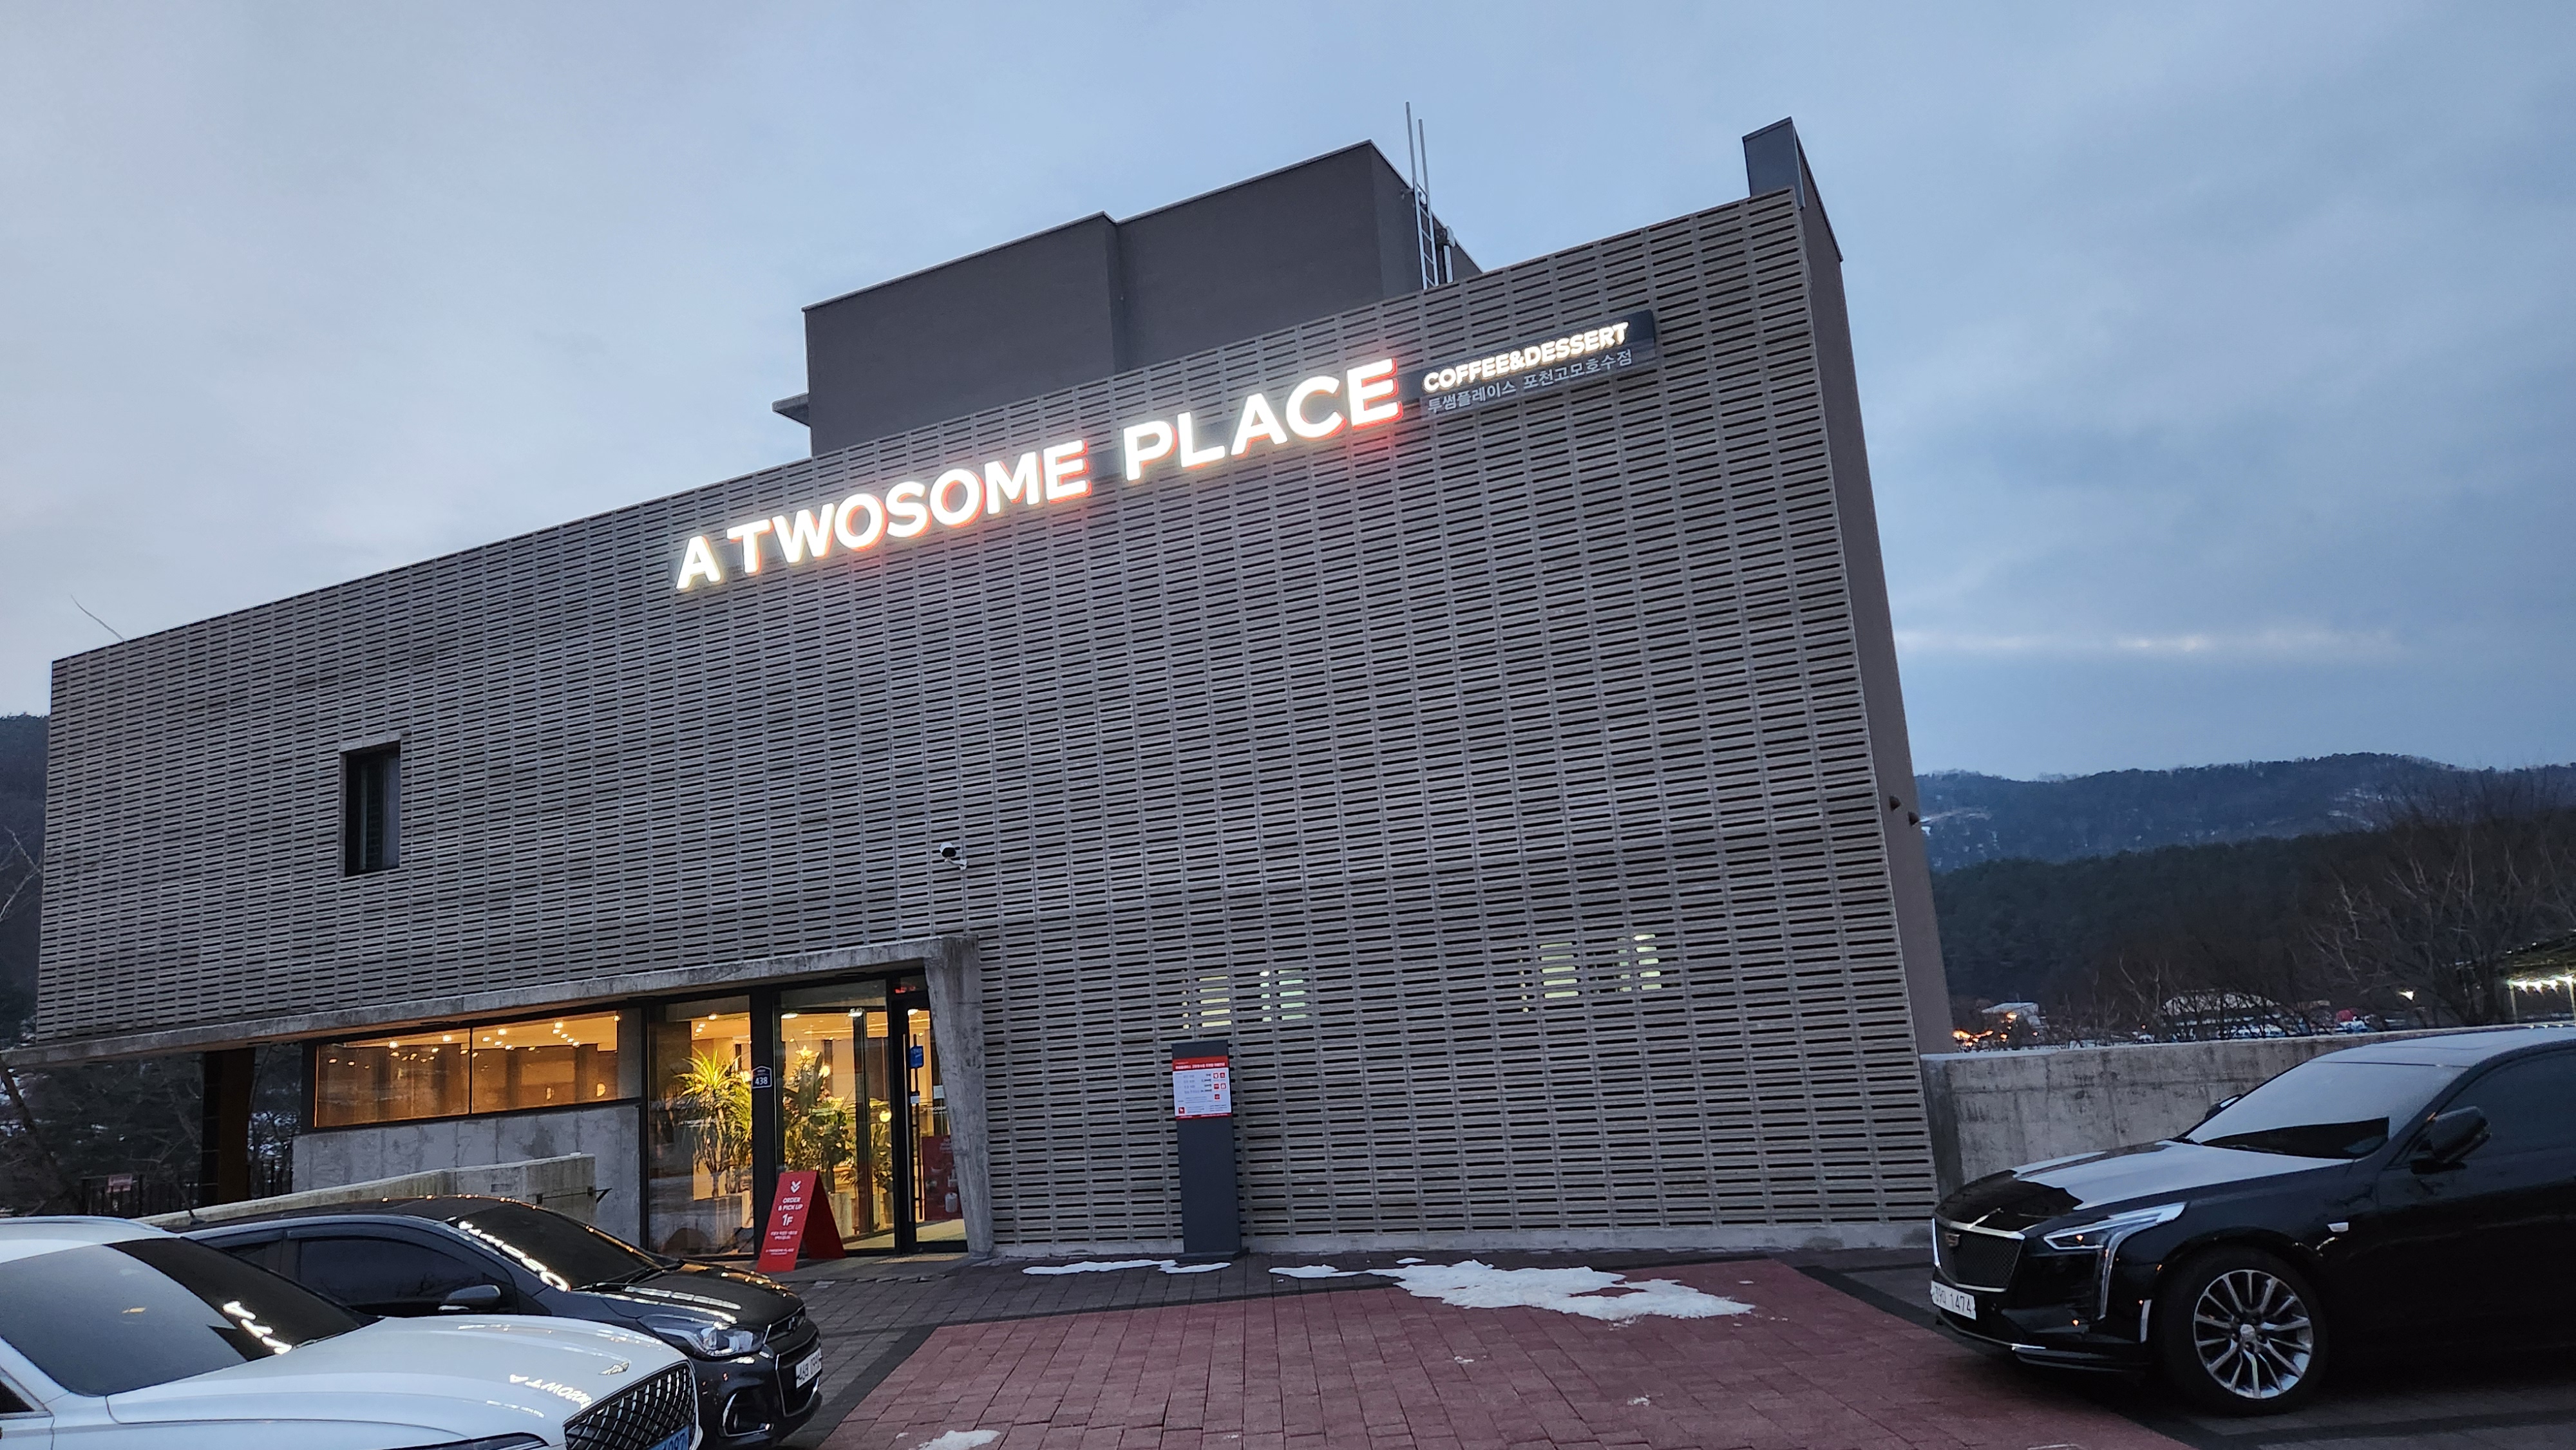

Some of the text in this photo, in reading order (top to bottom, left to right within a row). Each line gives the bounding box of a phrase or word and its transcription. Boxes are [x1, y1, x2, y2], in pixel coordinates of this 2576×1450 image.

[1423, 321, 1629, 392] COFFEE&DESSERT
[1428, 348, 1633, 413] 투썸플레이스 포천고모호수점
[676, 358, 1402, 590] A TWOSOME PLACE
[755, 1077, 768, 1085] 438
[782, 1213, 793, 1226] 1F
